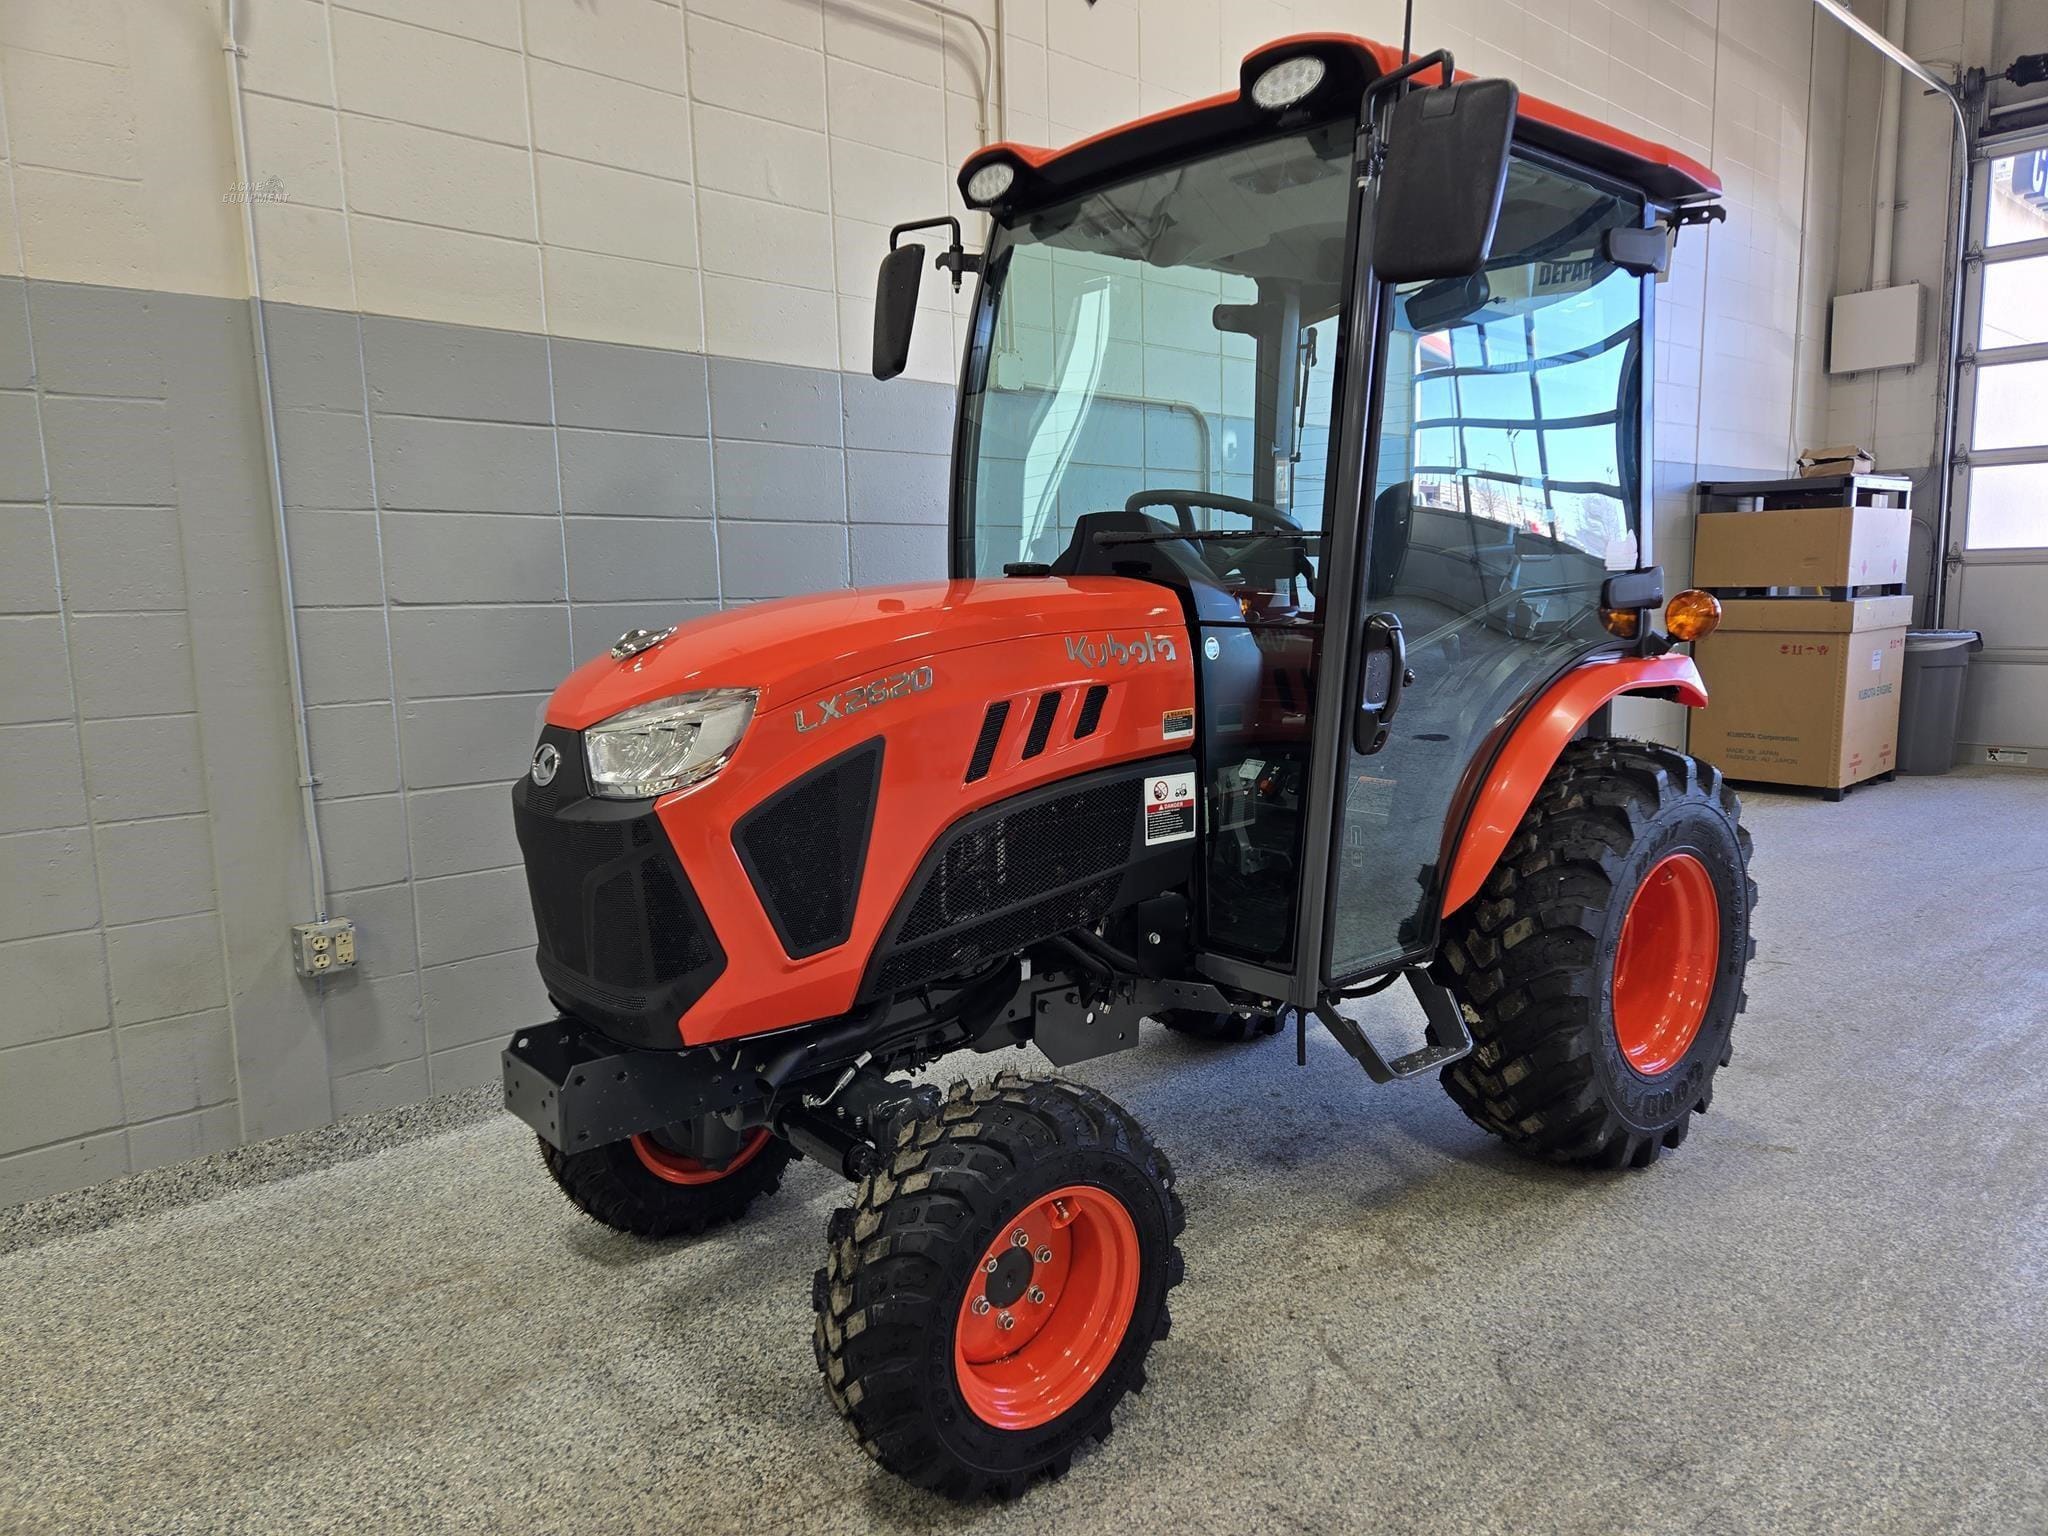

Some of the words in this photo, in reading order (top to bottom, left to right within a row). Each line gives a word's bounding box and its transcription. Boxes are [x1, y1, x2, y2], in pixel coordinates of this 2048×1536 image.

[1064, 630, 1177, 668] Kubota
[794, 665, 934, 733] LX2620
[1727, 731, 1756, 739] KUBOTA
[1758, 749, 1780, 757] JAPAN
[1164, 801, 1184, 810] DANGER
